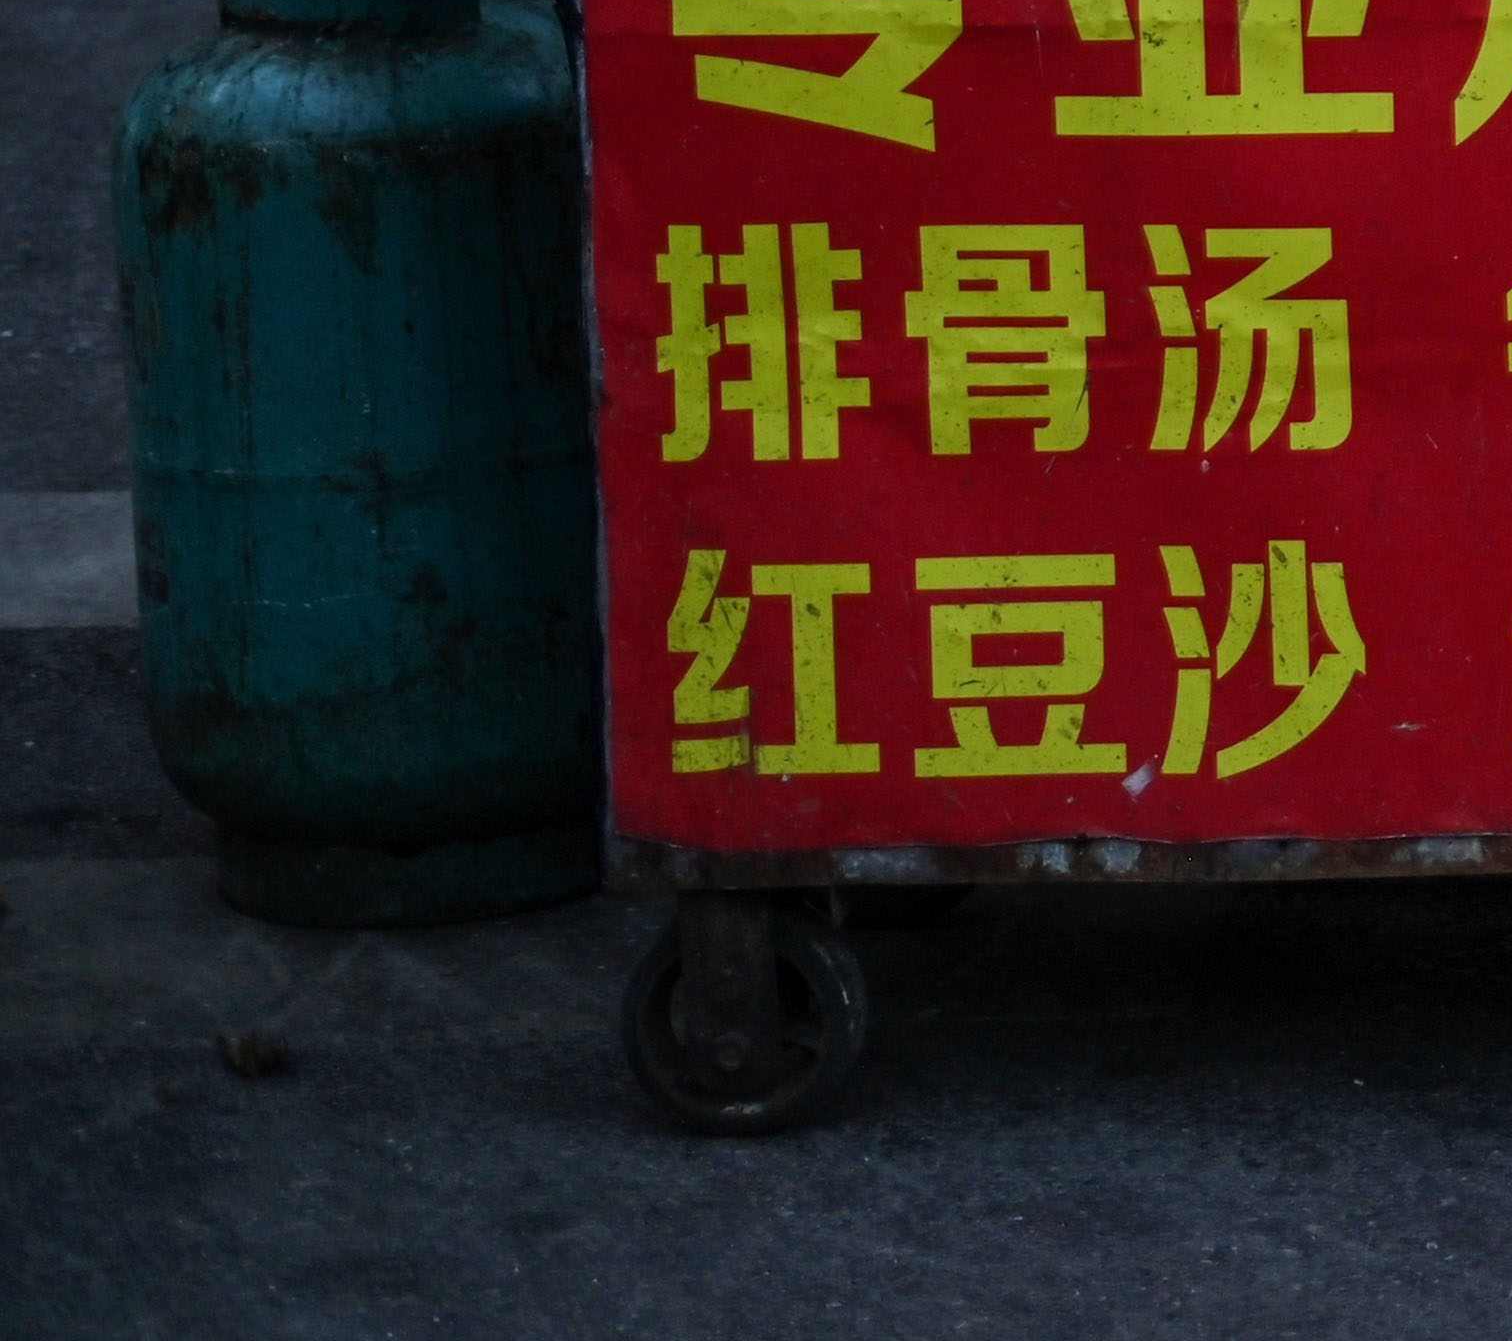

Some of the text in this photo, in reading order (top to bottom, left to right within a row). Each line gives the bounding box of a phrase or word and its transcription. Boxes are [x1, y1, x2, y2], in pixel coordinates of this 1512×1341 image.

[656, 222, 1352, 462] 排骨汤
[667, 540, 1366, 780] 红豆沙
